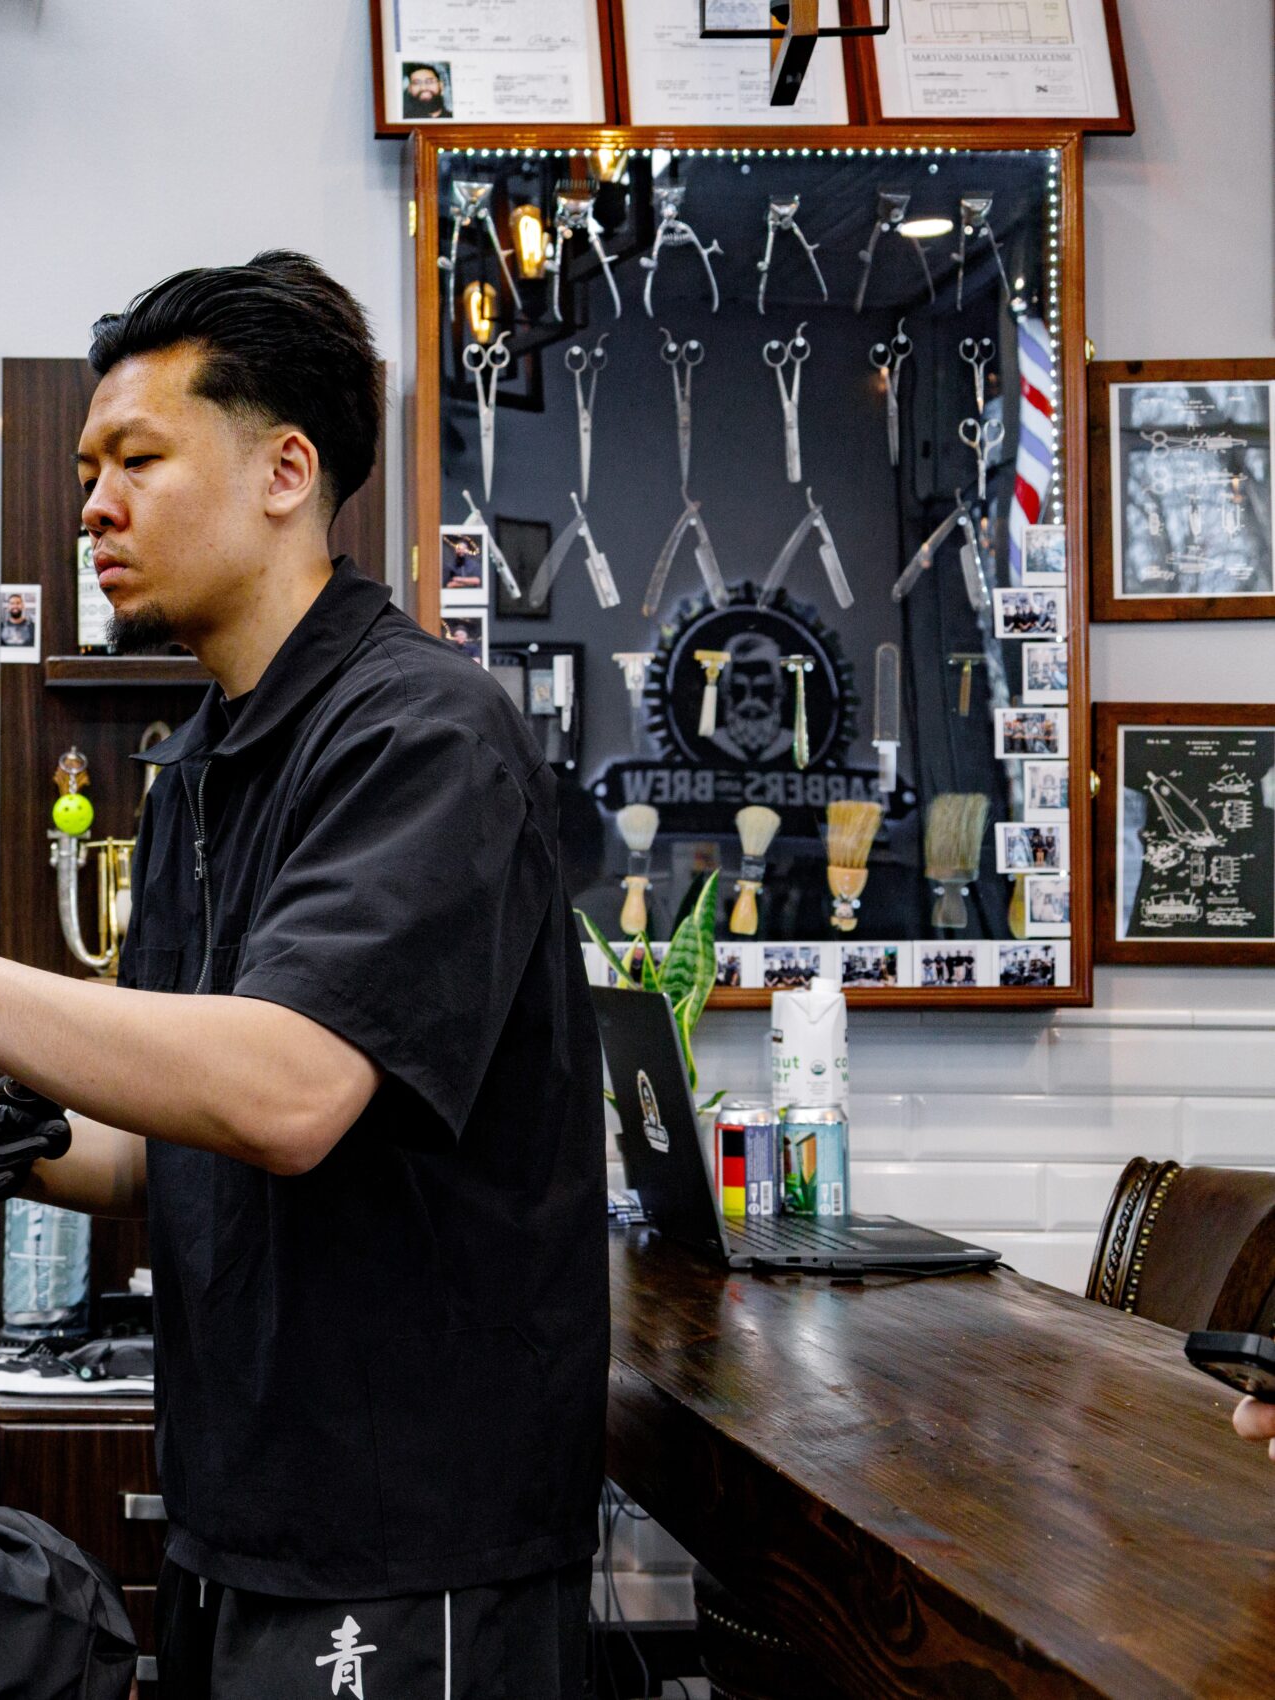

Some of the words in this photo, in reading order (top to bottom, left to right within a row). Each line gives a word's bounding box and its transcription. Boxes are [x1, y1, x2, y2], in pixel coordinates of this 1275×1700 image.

[912, 53, 963, 62] MARYLAND
[964, 53, 992, 62] SALES
[1019, 53, 1036, 62] TAX
[1036, 53, 1073, 62] LICENSE
[315, 1614, 377, 1700] 青
